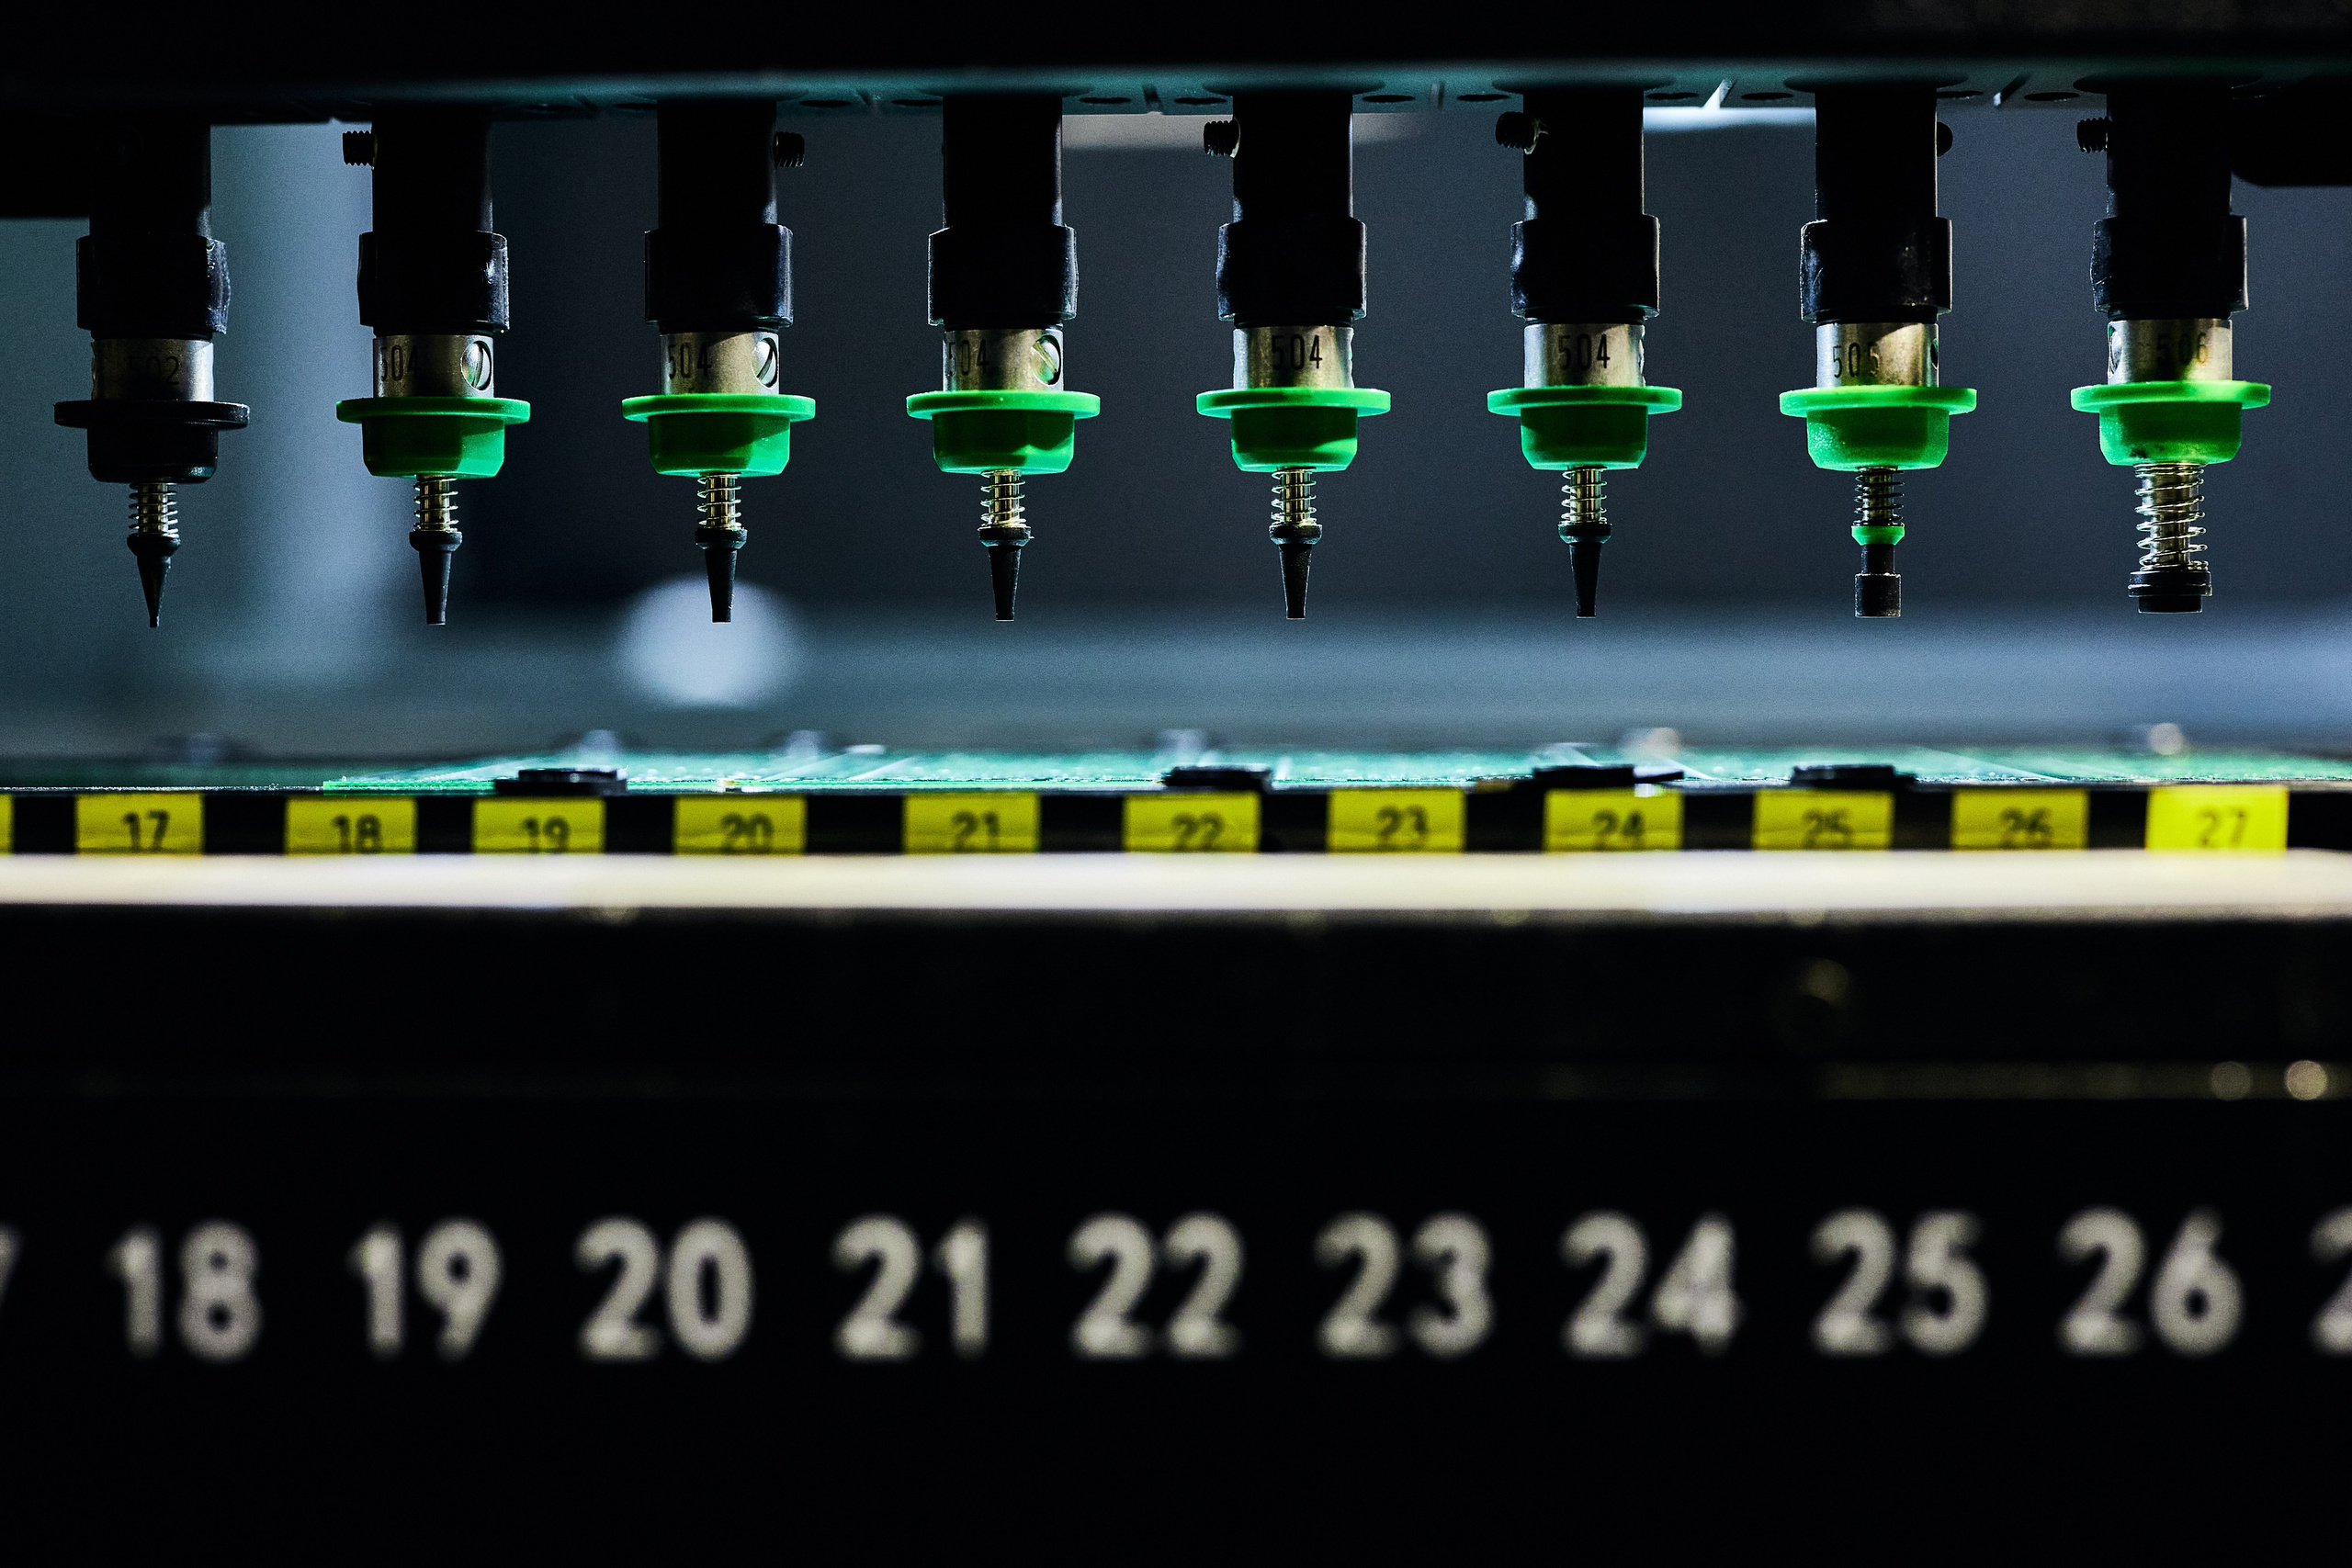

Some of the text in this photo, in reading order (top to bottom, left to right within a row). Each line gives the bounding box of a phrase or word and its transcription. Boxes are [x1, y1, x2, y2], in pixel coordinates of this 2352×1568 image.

[379, 344, 423, 382] 504
[667, 342, 712, 380] 504
[946, 339, 990, 378] 504
[1271, 333, 1323, 371] 504
[1558, 333, 1611, 370] 504
[2155, 331, 2209, 369] 506
[129, 355, 181, 389] 502
[121, 809, 171, 853] 17
[330, 814, 383, 852] 18
[520, 817, 571, 852] 19
[720, 812, 774, 852] 20
[951, 810, 1001, 852] 21
[1171, 811, 1225, 851] 22
[1374, 806, 1429, 850] 23
[1592, 809, 1645, 849] 24
[1802, 807, 1852, 849] 25
[1999, 807, 2052, 848] 26
[2197, 806, 2247, 847] 27
[112, 1222, 259, 1359] 18
[355, 1220, 502, 1359] 19
[578, 1218, 753, 1359] 20
[834, 1217, 990, 1359] 21
[1069, 1213, 1244, 1359] 22
[1318, 1213, 1494, 1357] 23
[1564, 1212, 1738, 1356] 24
[1814, 1210, 1988, 1354] 25
[2062, 1210, 2243, 1354] 26
